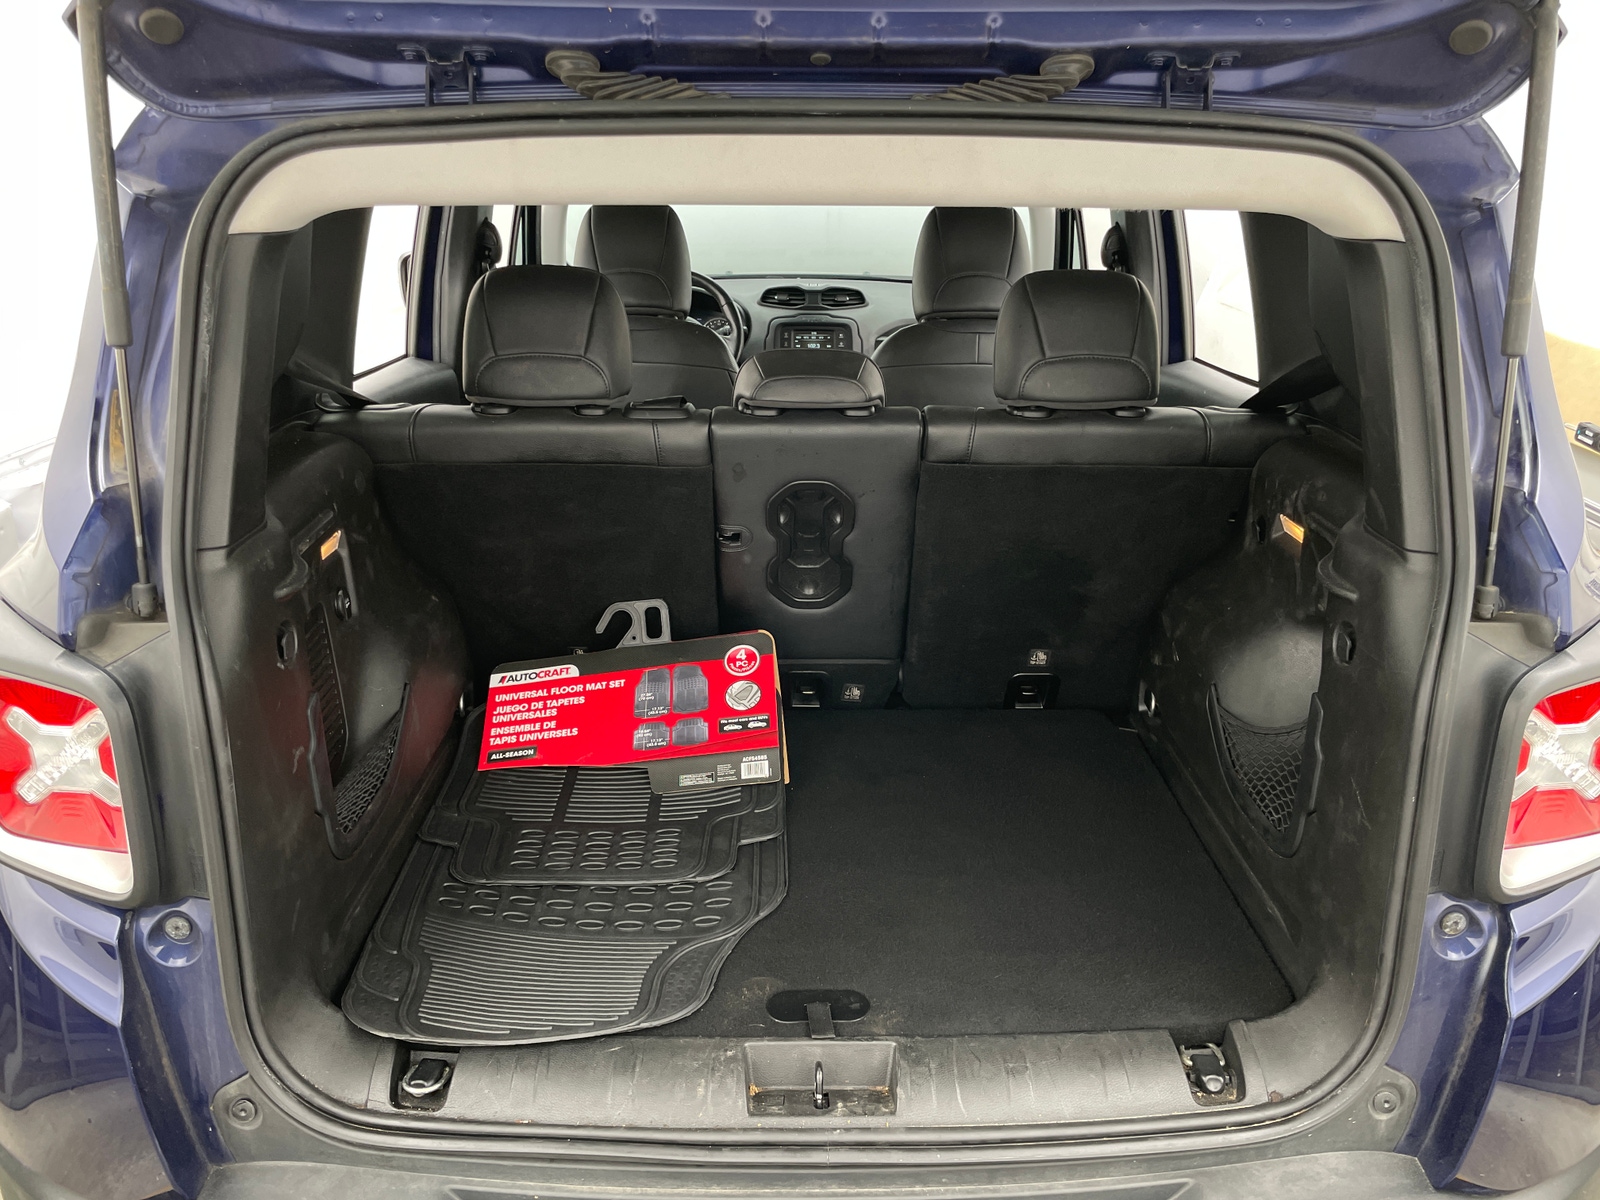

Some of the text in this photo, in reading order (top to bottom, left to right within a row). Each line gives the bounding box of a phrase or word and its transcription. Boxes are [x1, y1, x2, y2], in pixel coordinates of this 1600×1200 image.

[735, 648, 747, 660] 4
[735, 660, 748, 668] PC
[506, 667, 571, 684] AUTOCRAFT
[495, 679, 626, 703] UNIVERSAL FLOOR MAT SET
[493, 696, 586, 715] JUEGO DE TAPETES
[492, 708, 558, 724] UNIVERSALES
[490, 720, 557, 736] ENSEMBLE DE
[489, 728, 579, 746] TAPIS UNIVERSELS
[491, 748, 535, 760] ALL-SEASON
